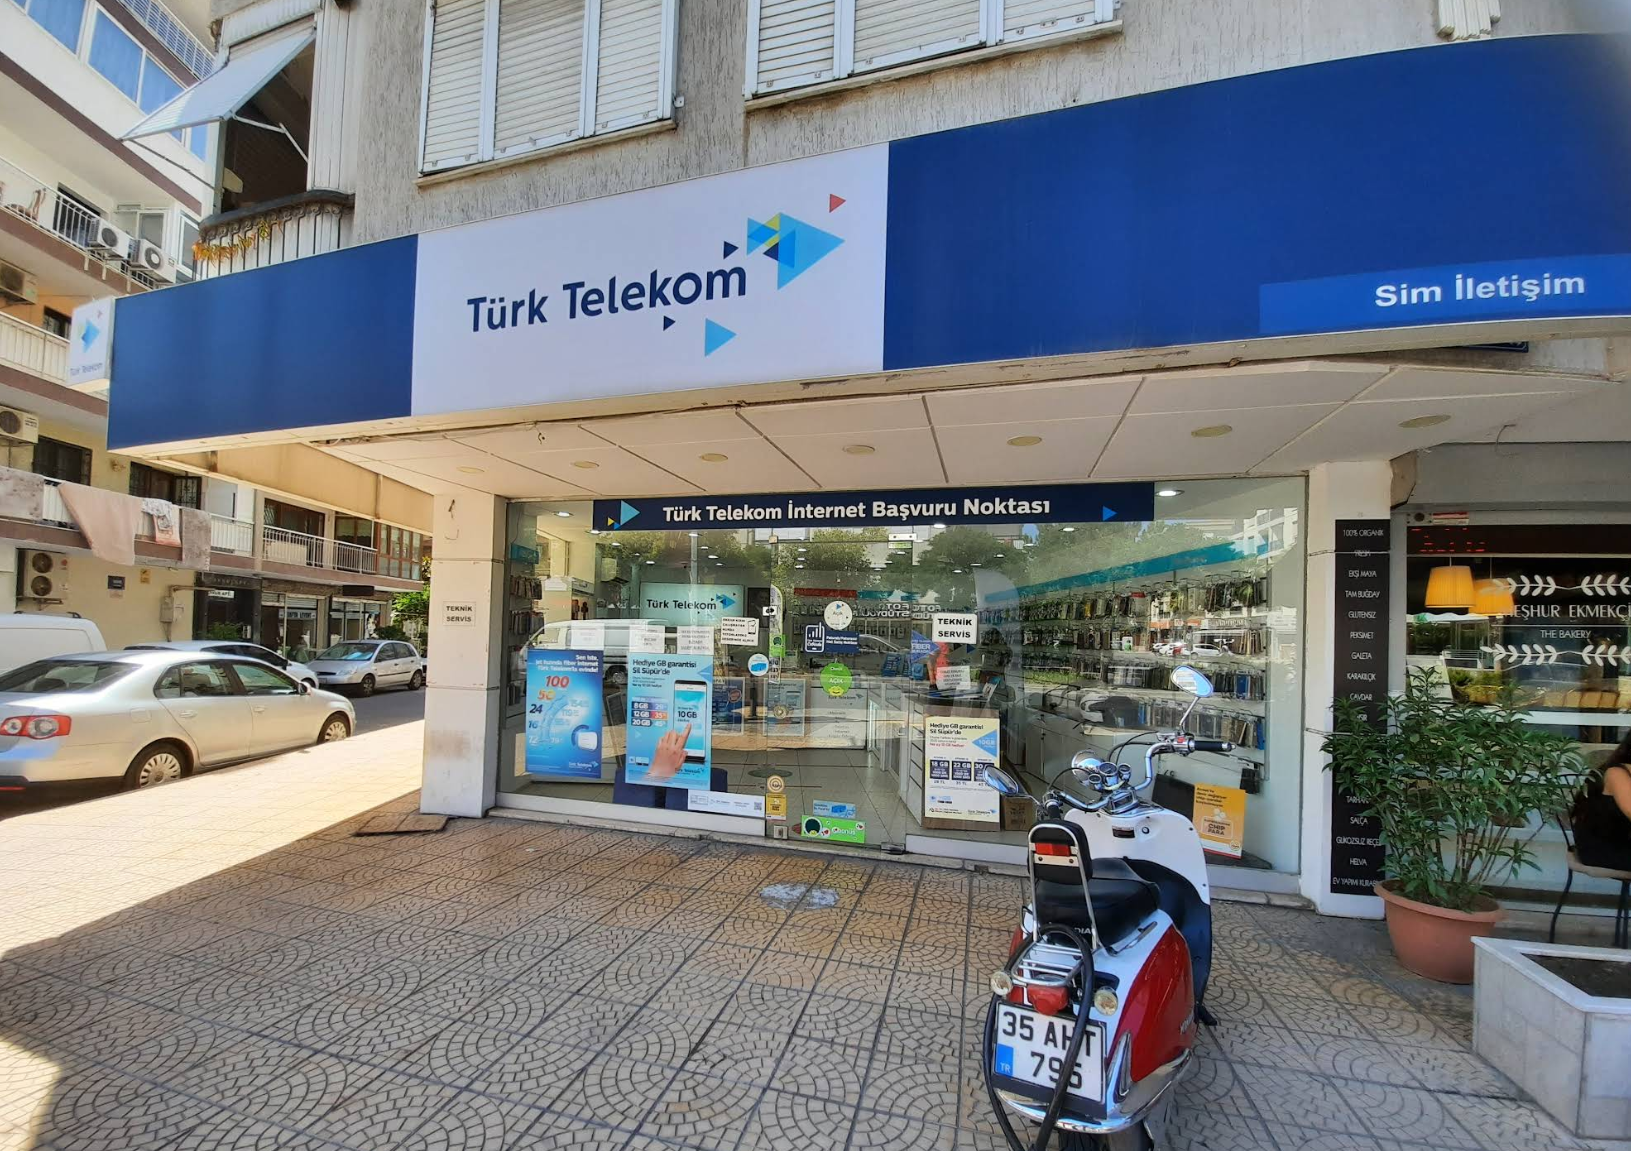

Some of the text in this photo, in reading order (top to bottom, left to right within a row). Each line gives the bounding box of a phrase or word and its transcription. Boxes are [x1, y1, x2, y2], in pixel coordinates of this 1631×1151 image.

[1375, 273, 1585, 307] Sim İletişim
[467, 266, 747, 332] Türk Telekom
[663, 497, 1050, 522] Türk Telekom İnternet Başvuru Noktası
[1343, 529, 1358, 537] 100%
[1360, 570, 1377, 578] MAYA
[1345, 590, 1357, 598] TAM
[646, 598, 717, 610] Türk Telekom
[938, 618, 972, 626] TEKNİK
[938, 630, 971, 638] SERVİS
[1541, 630, 1591, 639] THE BAKERY
[1351, 652, 1373, 660] GALETA
[632, 659, 697, 669] Hediye GB garantisi
[641, 667, 671, 676] Süpür'de
[545, 675, 570, 688] 100
[529, 703, 543, 714] 24
[633, 710, 640, 718] 12
[677, 710, 698, 719] 10 GB
[1350, 816, 1369, 827] SALÇA
[1208, 823, 1226, 831] CHIP
[1207, 828, 1225, 836] PARA
[1349, 857, 1368, 866] HELVA
[1332, 876, 1340, 885] EV
[1002, 1011, 1034, 1042] 35
[1000, 1062, 1011, 1074] TR
